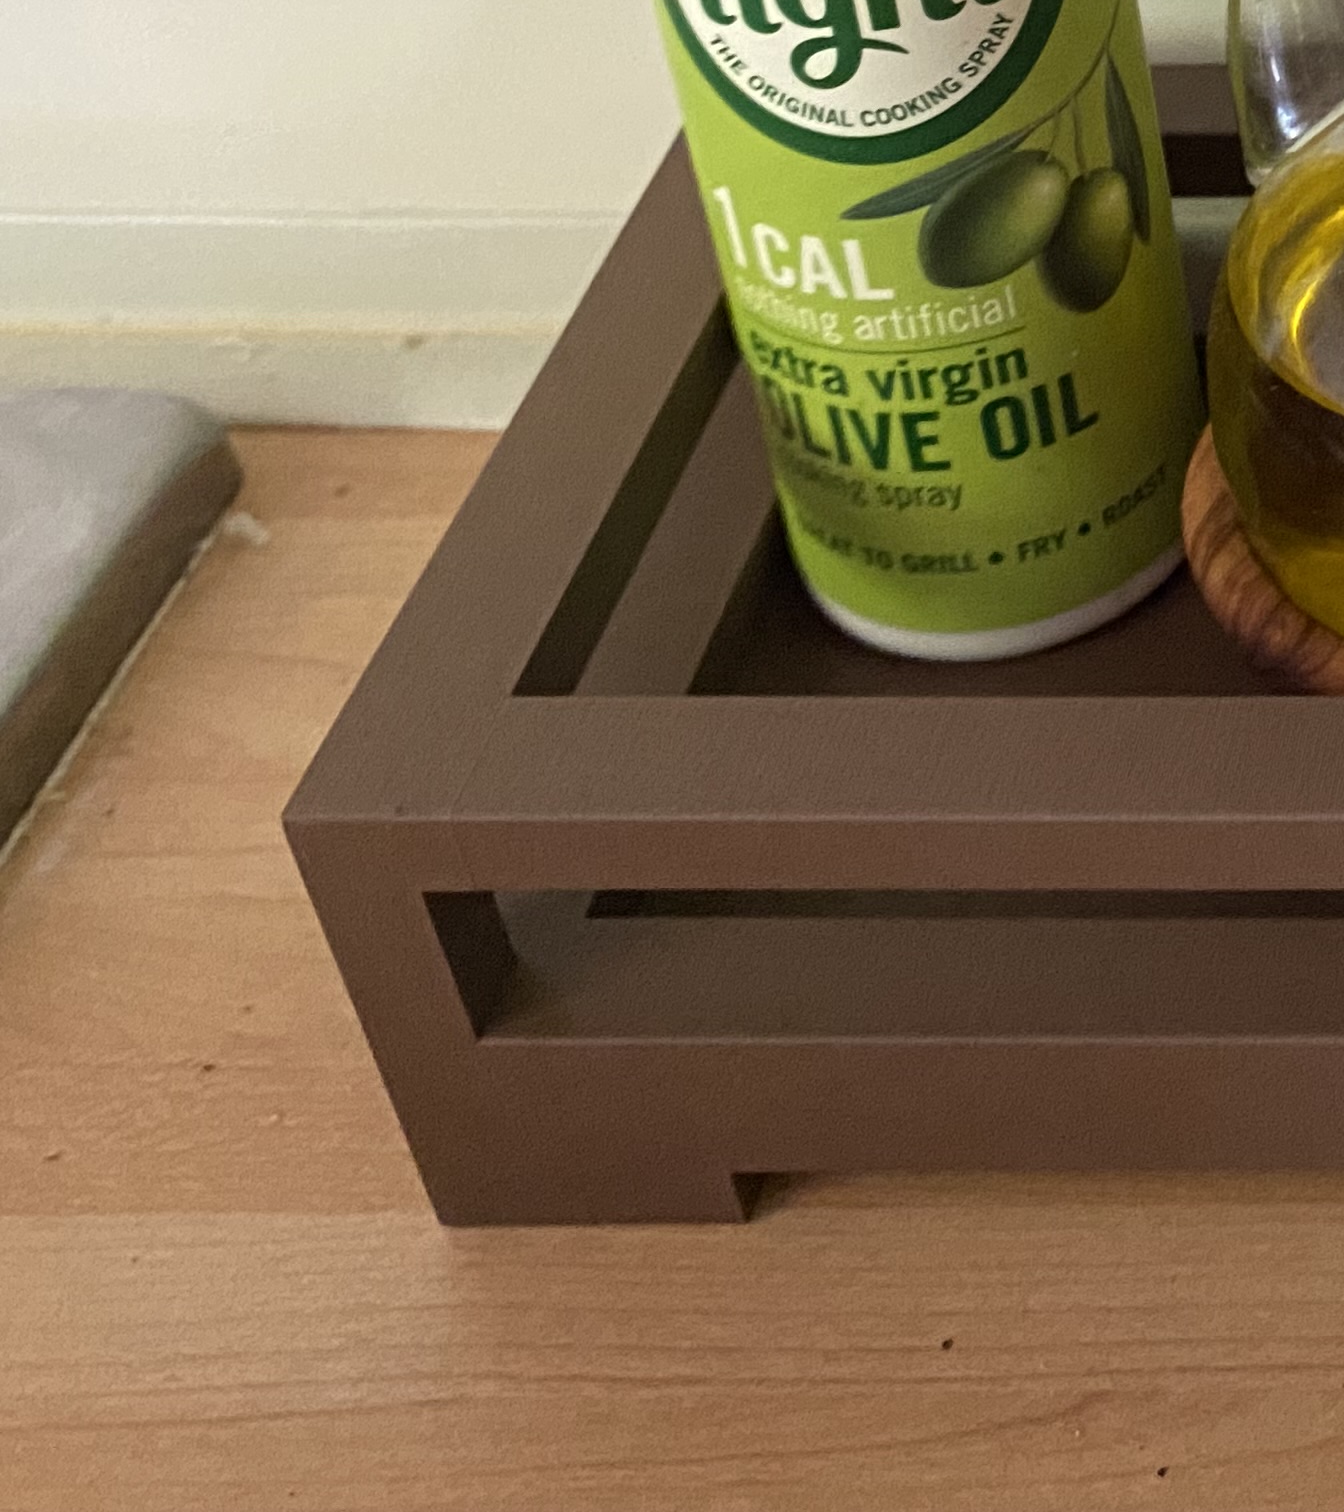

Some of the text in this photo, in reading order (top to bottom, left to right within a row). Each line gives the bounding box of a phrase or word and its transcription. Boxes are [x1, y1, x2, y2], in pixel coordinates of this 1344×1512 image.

[710, 13, 1015, 128] THE ORIGINAL COOKING SPRAY
[751, 222, 895, 301] CAL
[853, 284, 1017, 341] artificial
[750, 330, 1029, 406] extra virgin
[978, 372, 1100, 463] OIL
[876, 482, 963, 511] spray
[1015, 527, 1068, 564] FRY
